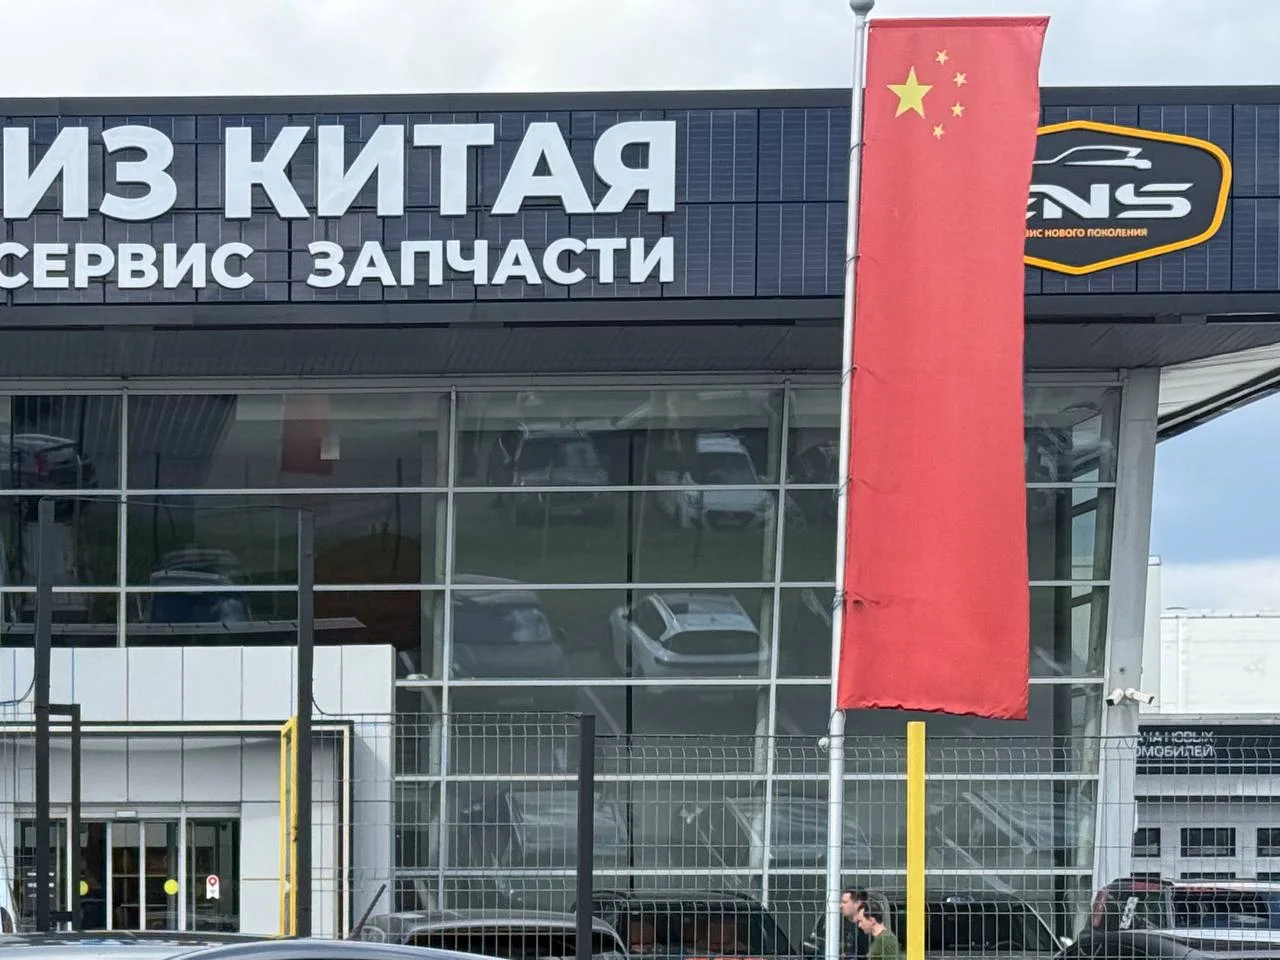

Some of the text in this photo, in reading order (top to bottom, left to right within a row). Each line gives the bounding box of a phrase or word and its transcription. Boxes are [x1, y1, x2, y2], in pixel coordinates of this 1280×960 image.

[3, 125, 177, 221] ИЗ
[224, 120, 677, 219] КИТАЯ
[1025, 183, 1195, 220] NS
[1044, 228, 1086, 238] НОВОГО
[1087, 227, 1148, 238] ПОКОЛЕНИЯ
[306, 237, 675, 289] ЗАПЧАСТИ
